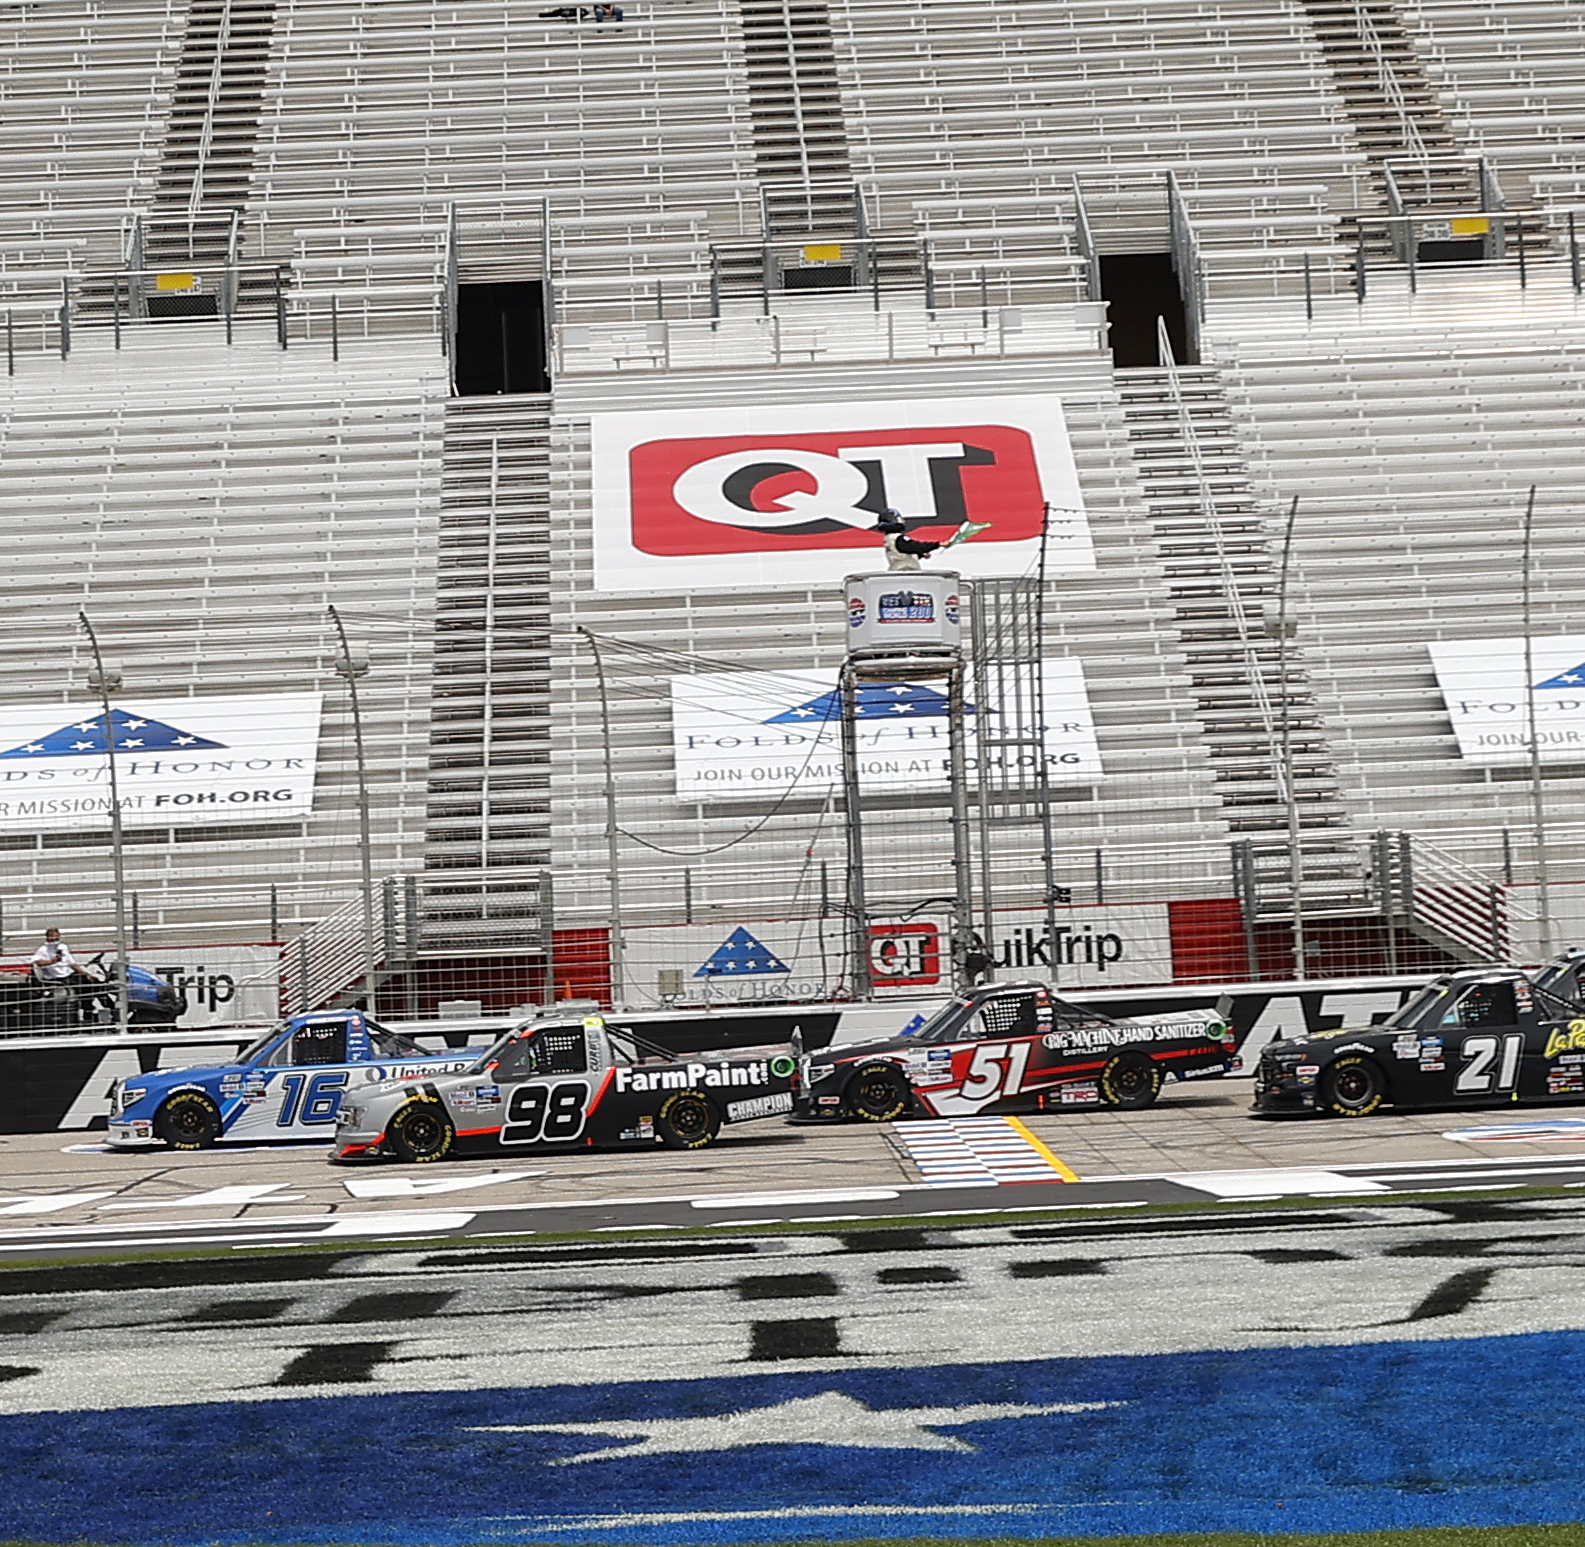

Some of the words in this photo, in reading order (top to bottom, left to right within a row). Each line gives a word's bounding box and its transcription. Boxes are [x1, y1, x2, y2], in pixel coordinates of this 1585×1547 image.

[672, 442, 975, 532] QT
[684, 733, 833, 751] FOLDS
[1478, 733, 1524, 747] JOIN
[1535, 728, 1581, 745] OUR
[71, 765, 108, 783] of
[127, 756, 305, 777] HONOR
[694, 767, 744, 782] JOIN
[750, 765, 799, 781] OUR
[805, 759, 899, 779] MISION
[908, 759, 933, 774] AT
[17, 797, 112, 816] MISSION
[155, 788, 294, 808] FOH.ORG
[871, 930, 931, 978] QT
[674, 984, 726, 1001] OLDS
[1124, 1026, 1154, 1042] HAND
[1155, 1023, 1207, 1041] SANITIZER
[961, 1042, 1031, 1100] 51
[1455, 1034, 1522, 1092] 21
[277, 1073, 350, 1128] 16
[500, 1079, 592, 1145] 98
[727, 1091, 795, 1118] CHAMPION
